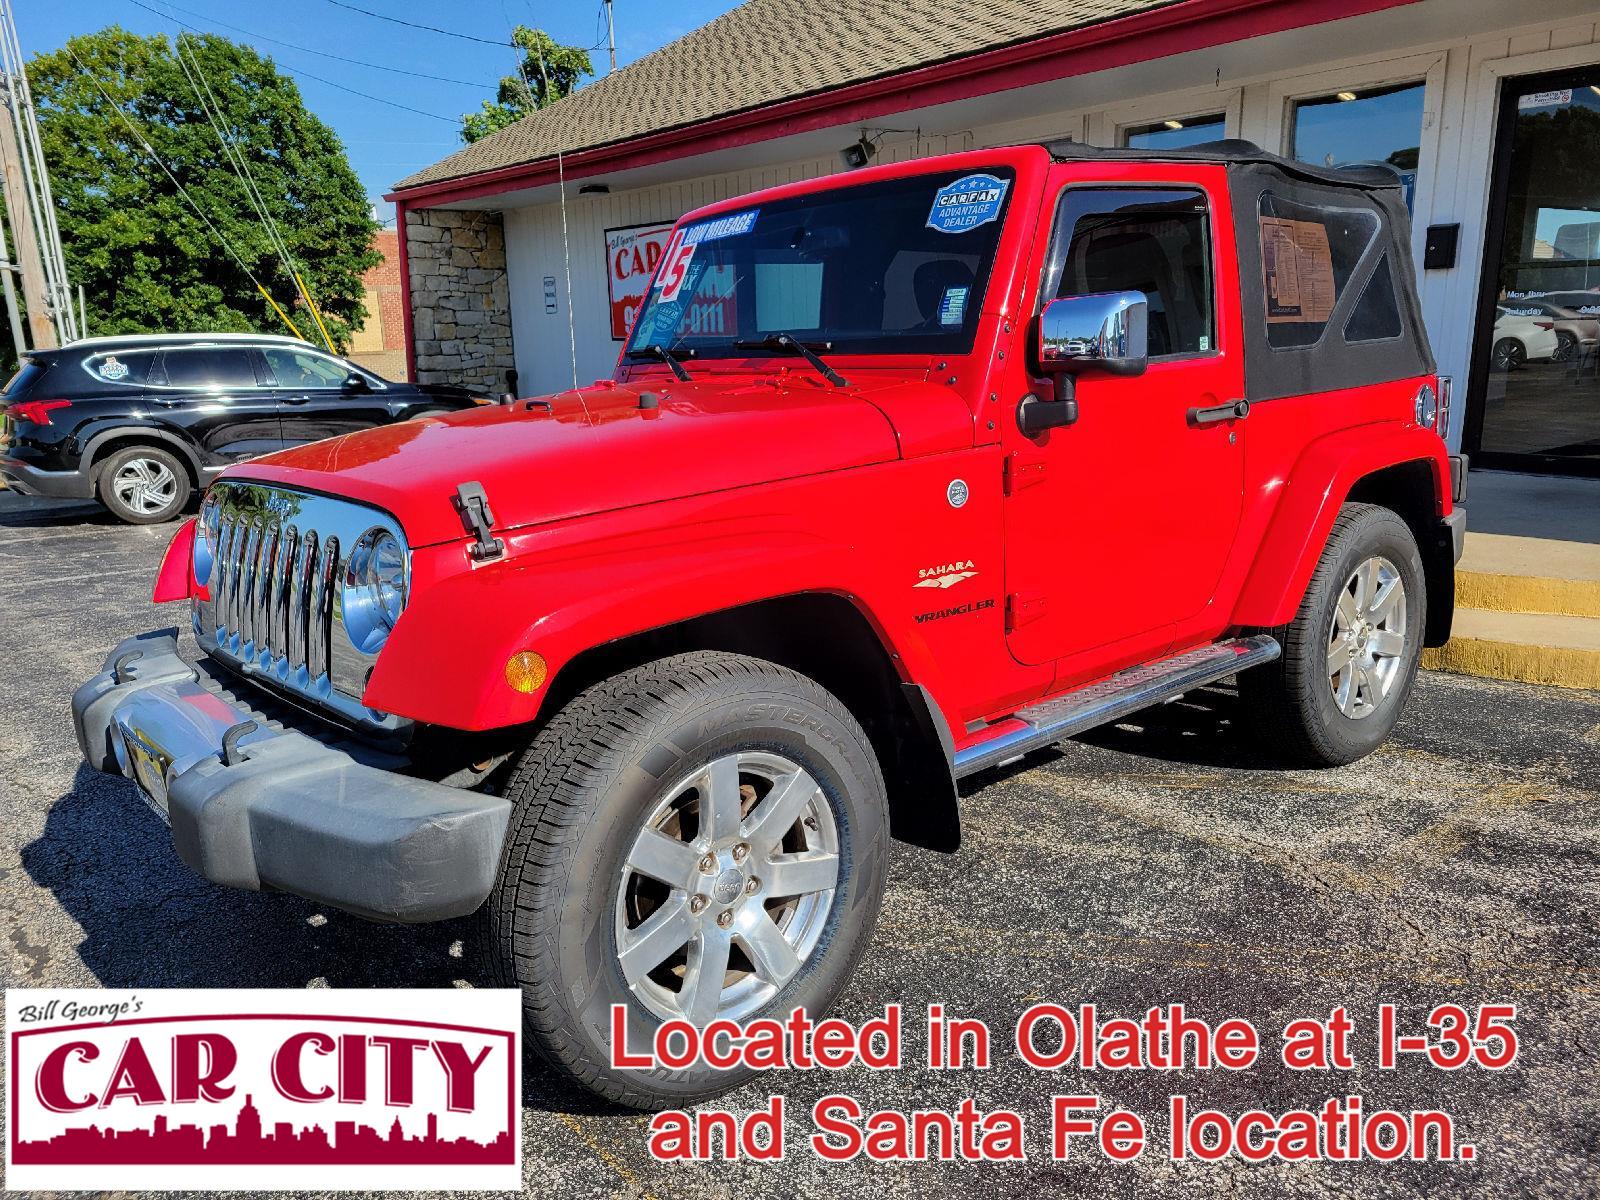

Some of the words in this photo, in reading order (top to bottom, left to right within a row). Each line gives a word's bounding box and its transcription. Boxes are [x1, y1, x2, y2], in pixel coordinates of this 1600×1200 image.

[940, 190, 999, 205] CARFAX
[939, 204, 990, 217] ADVANTAGE
[704, 212, 756, 241] MILEAGE
[943, 216, 977, 227] DEALER
[918, 560, 975, 579] SAHARA
[914, 600, 995, 624] WRANGLER
